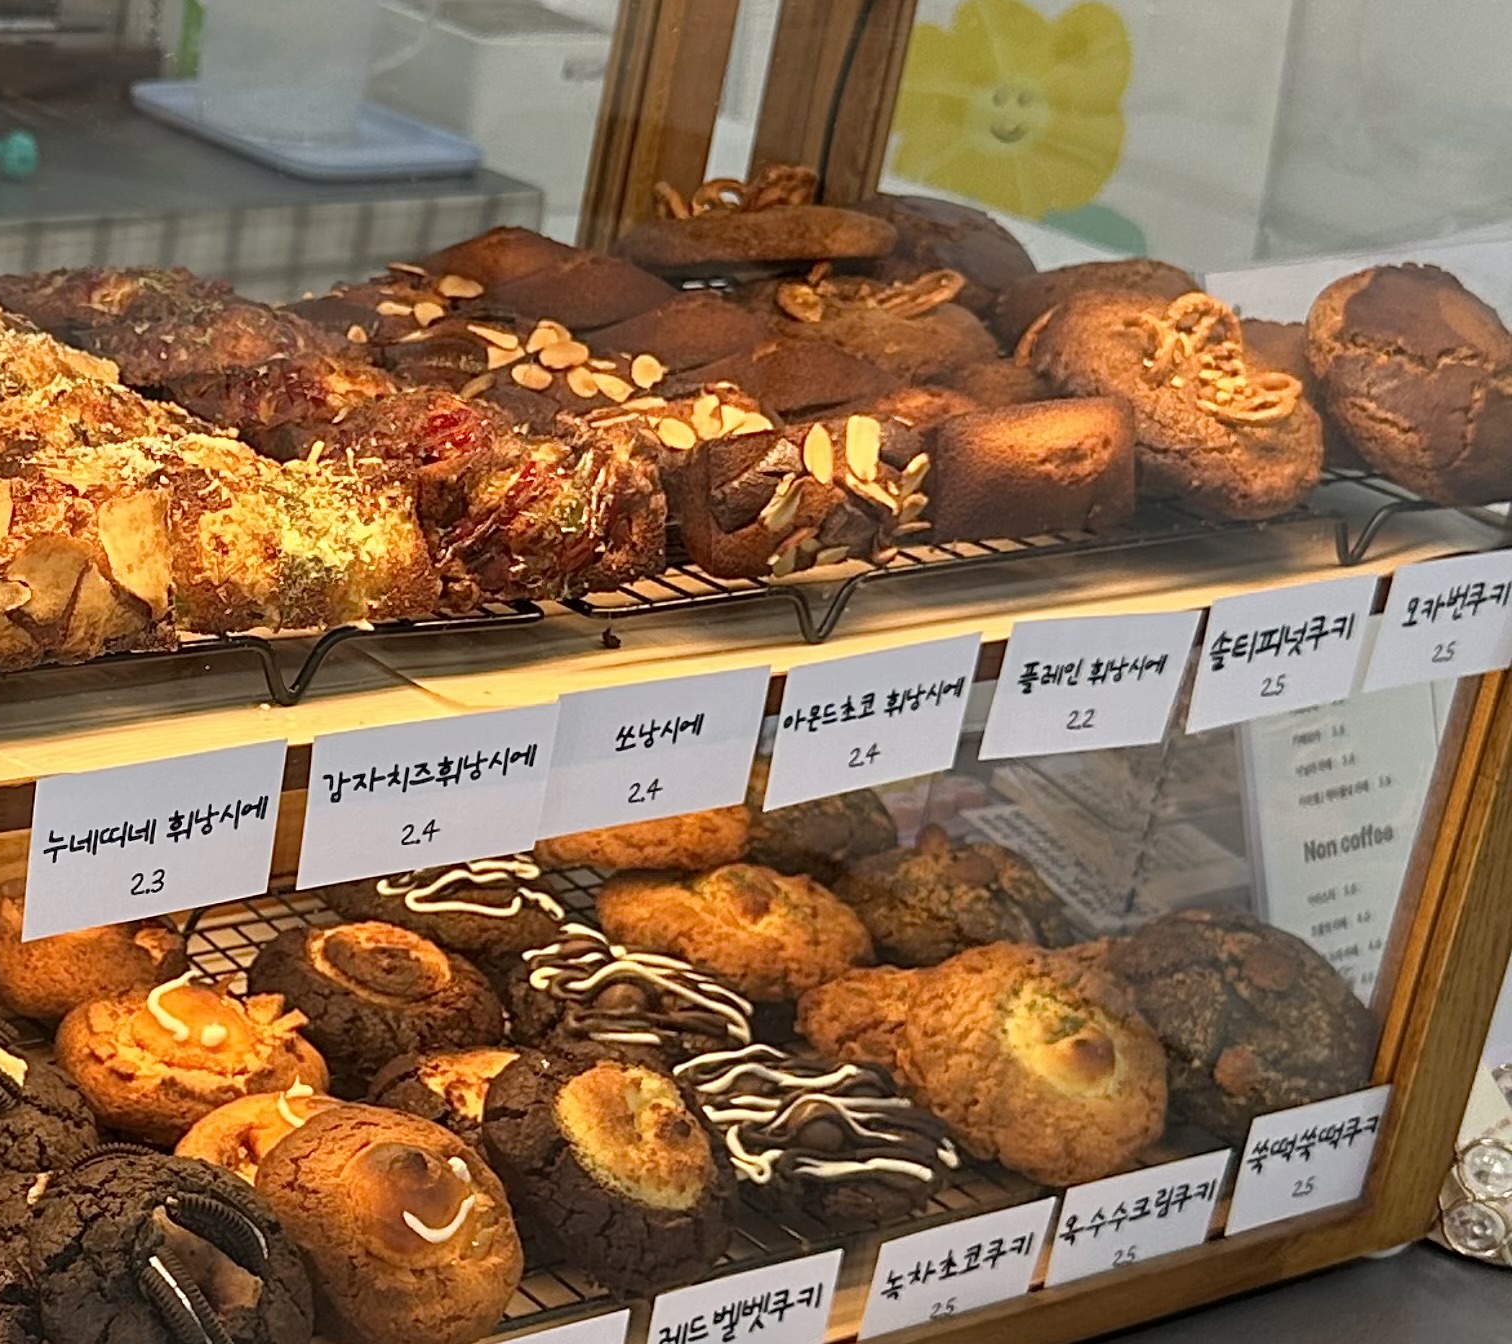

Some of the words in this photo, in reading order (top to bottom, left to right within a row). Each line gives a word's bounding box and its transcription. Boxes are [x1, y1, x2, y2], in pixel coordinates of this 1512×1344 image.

[1208, 612, 1355, 672] 솔티피넛쿠키
[1018, 658, 1084, 695] 플레인
[1087, 653, 1169, 686] 휘낭시에
[783, 691, 876, 733] 아몬드초코
[884, 675, 967, 718] 휘낭시에
[615, 713, 705, 751] 쏘낭시에
[628, 778, 663, 803] 2.4
[43, 818, 157, 863] 누네띠네
[166, 795, 269, 843] 휘낭시에
[401, 819, 440, 846] 2.4
[1303, 839, 1337, 863] Non
[1340, 823, 1394, 852] coffee
[130, 868, 166, 896] 2.3
[1059, 1178, 1218, 1246] 옥수수크림쿠키
[880, 1231, 1035, 1300] 녹차초코쿠키
